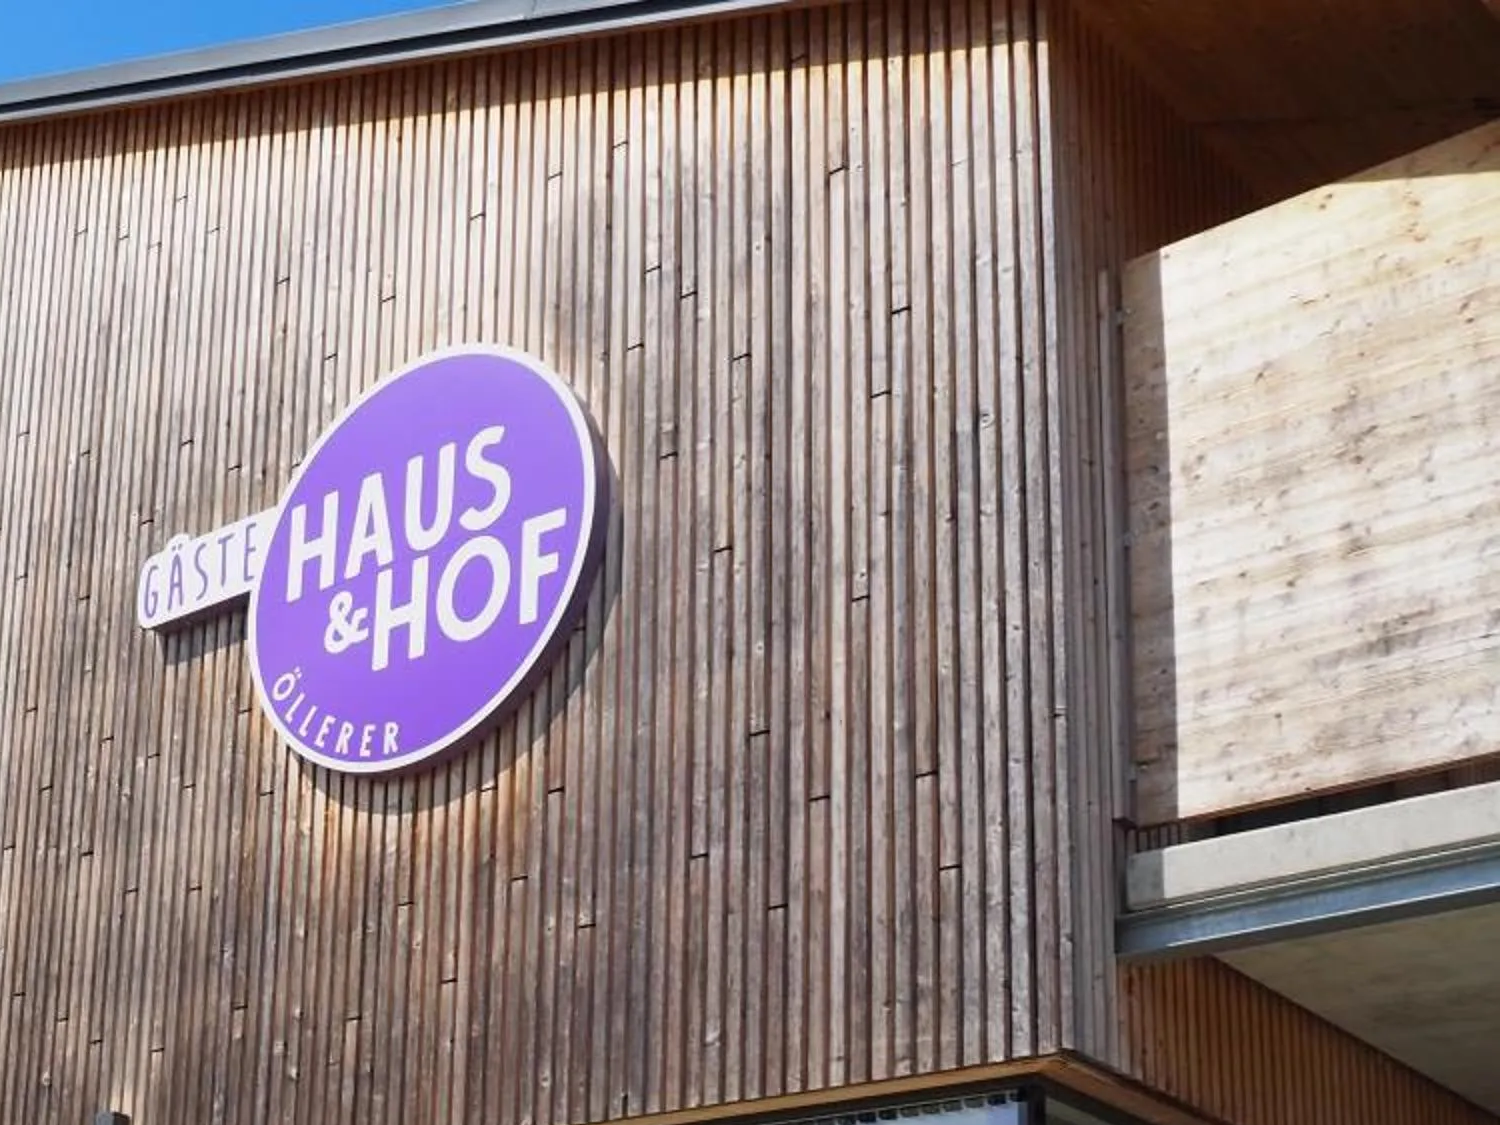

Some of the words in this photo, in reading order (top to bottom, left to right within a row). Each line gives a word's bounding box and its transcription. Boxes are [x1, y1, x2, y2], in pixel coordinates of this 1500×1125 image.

[286, 425, 512, 604] HAUS
[143, 521, 260, 620] GÄSTE
[271, 666, 400, 759] ÖLLERER
